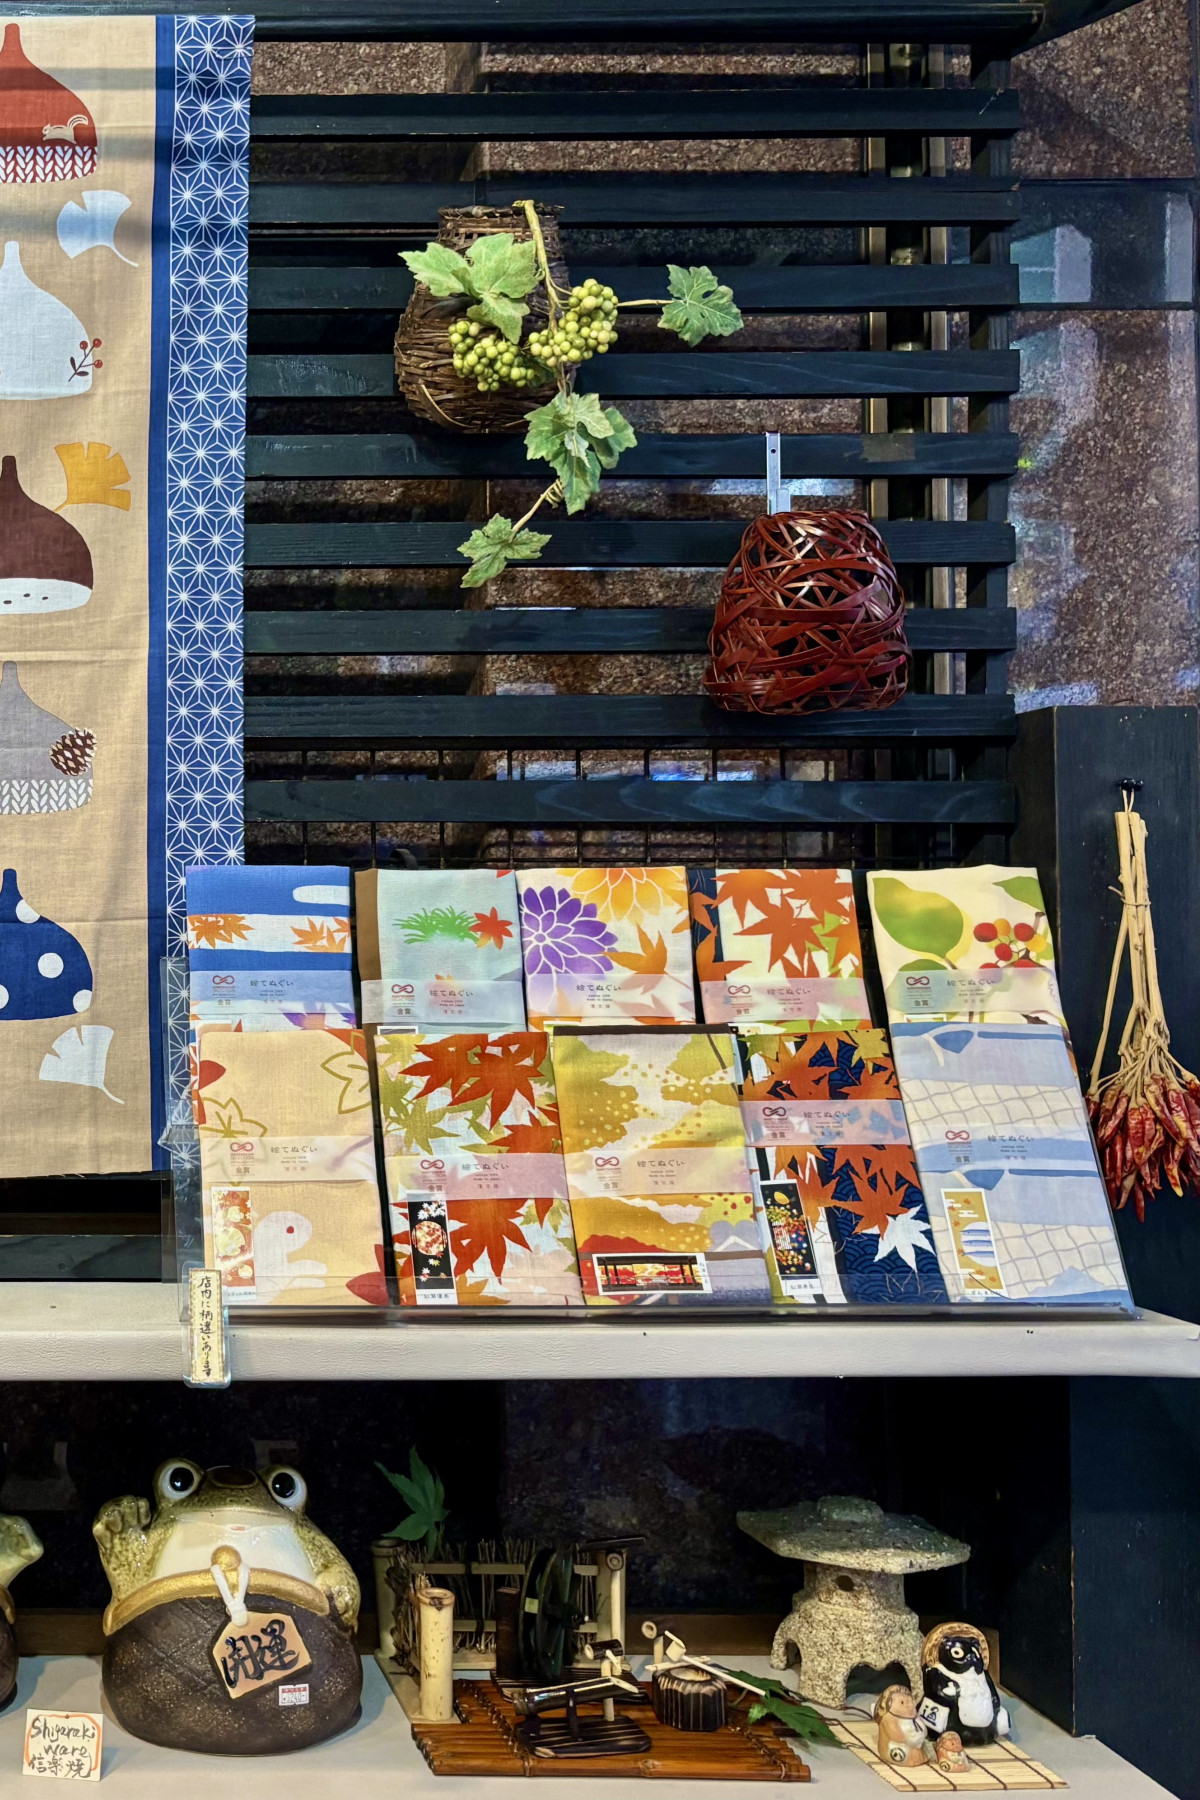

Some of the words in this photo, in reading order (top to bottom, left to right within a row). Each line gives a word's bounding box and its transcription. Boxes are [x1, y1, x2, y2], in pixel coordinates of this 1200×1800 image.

[221, 1618, 300, 1689] 開運
[30, 1716, 96, 1743] Shigaraki
[28, 1752, 92, 1779] 信楽焼
